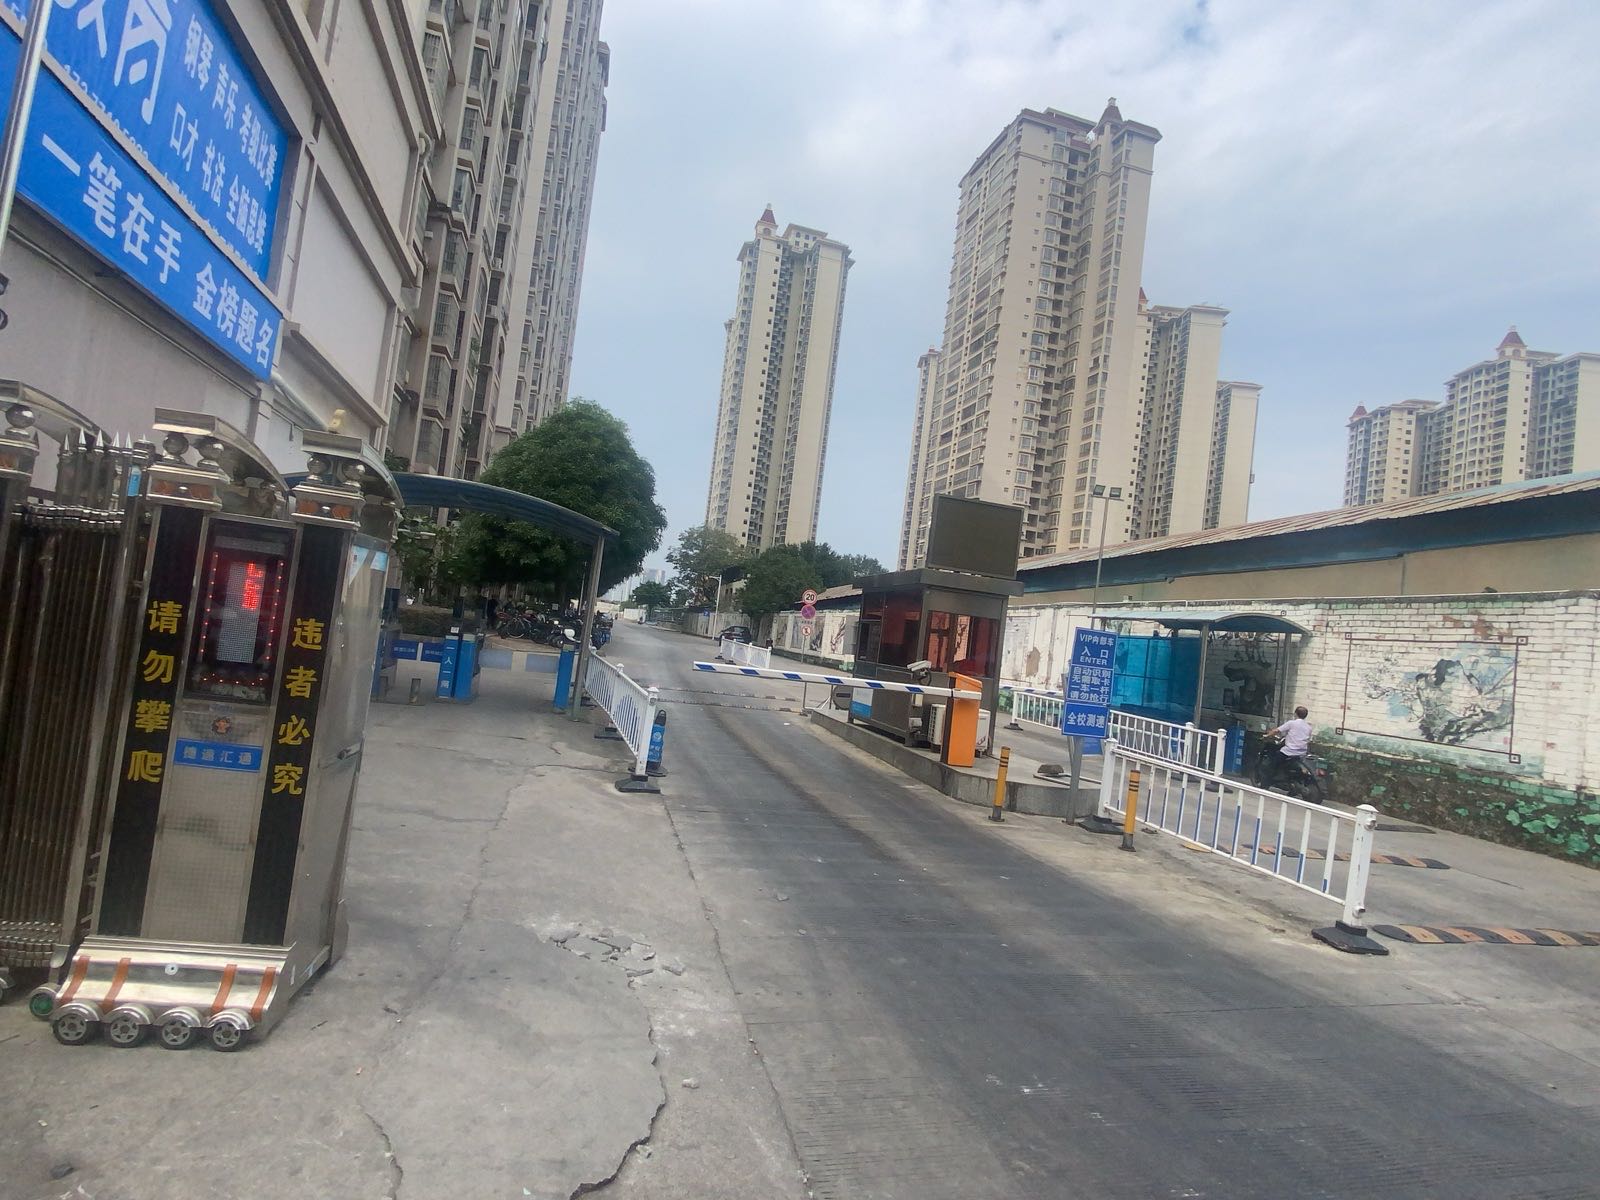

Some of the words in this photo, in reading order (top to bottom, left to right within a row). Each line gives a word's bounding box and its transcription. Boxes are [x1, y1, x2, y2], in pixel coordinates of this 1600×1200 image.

[185, 14, 214, 91] 钢琴
[170, 102, 199, 171] 口才
[202, 138, 226, 207] 书法
[42, 134, 182, 284] 一笔在手
[192, 262, 274, 368] 金榜题名
[806, 593, 815, 601] 20
[1073, 667, 1111, 679] 自动识别
[1080, 634, 1114, 647] VIP内部车
[1080, 656, 1108, 666] ENTER
[127, 601, 183, 783] 请勿攀爬
[271, 618, 326, 795] 违者必究
